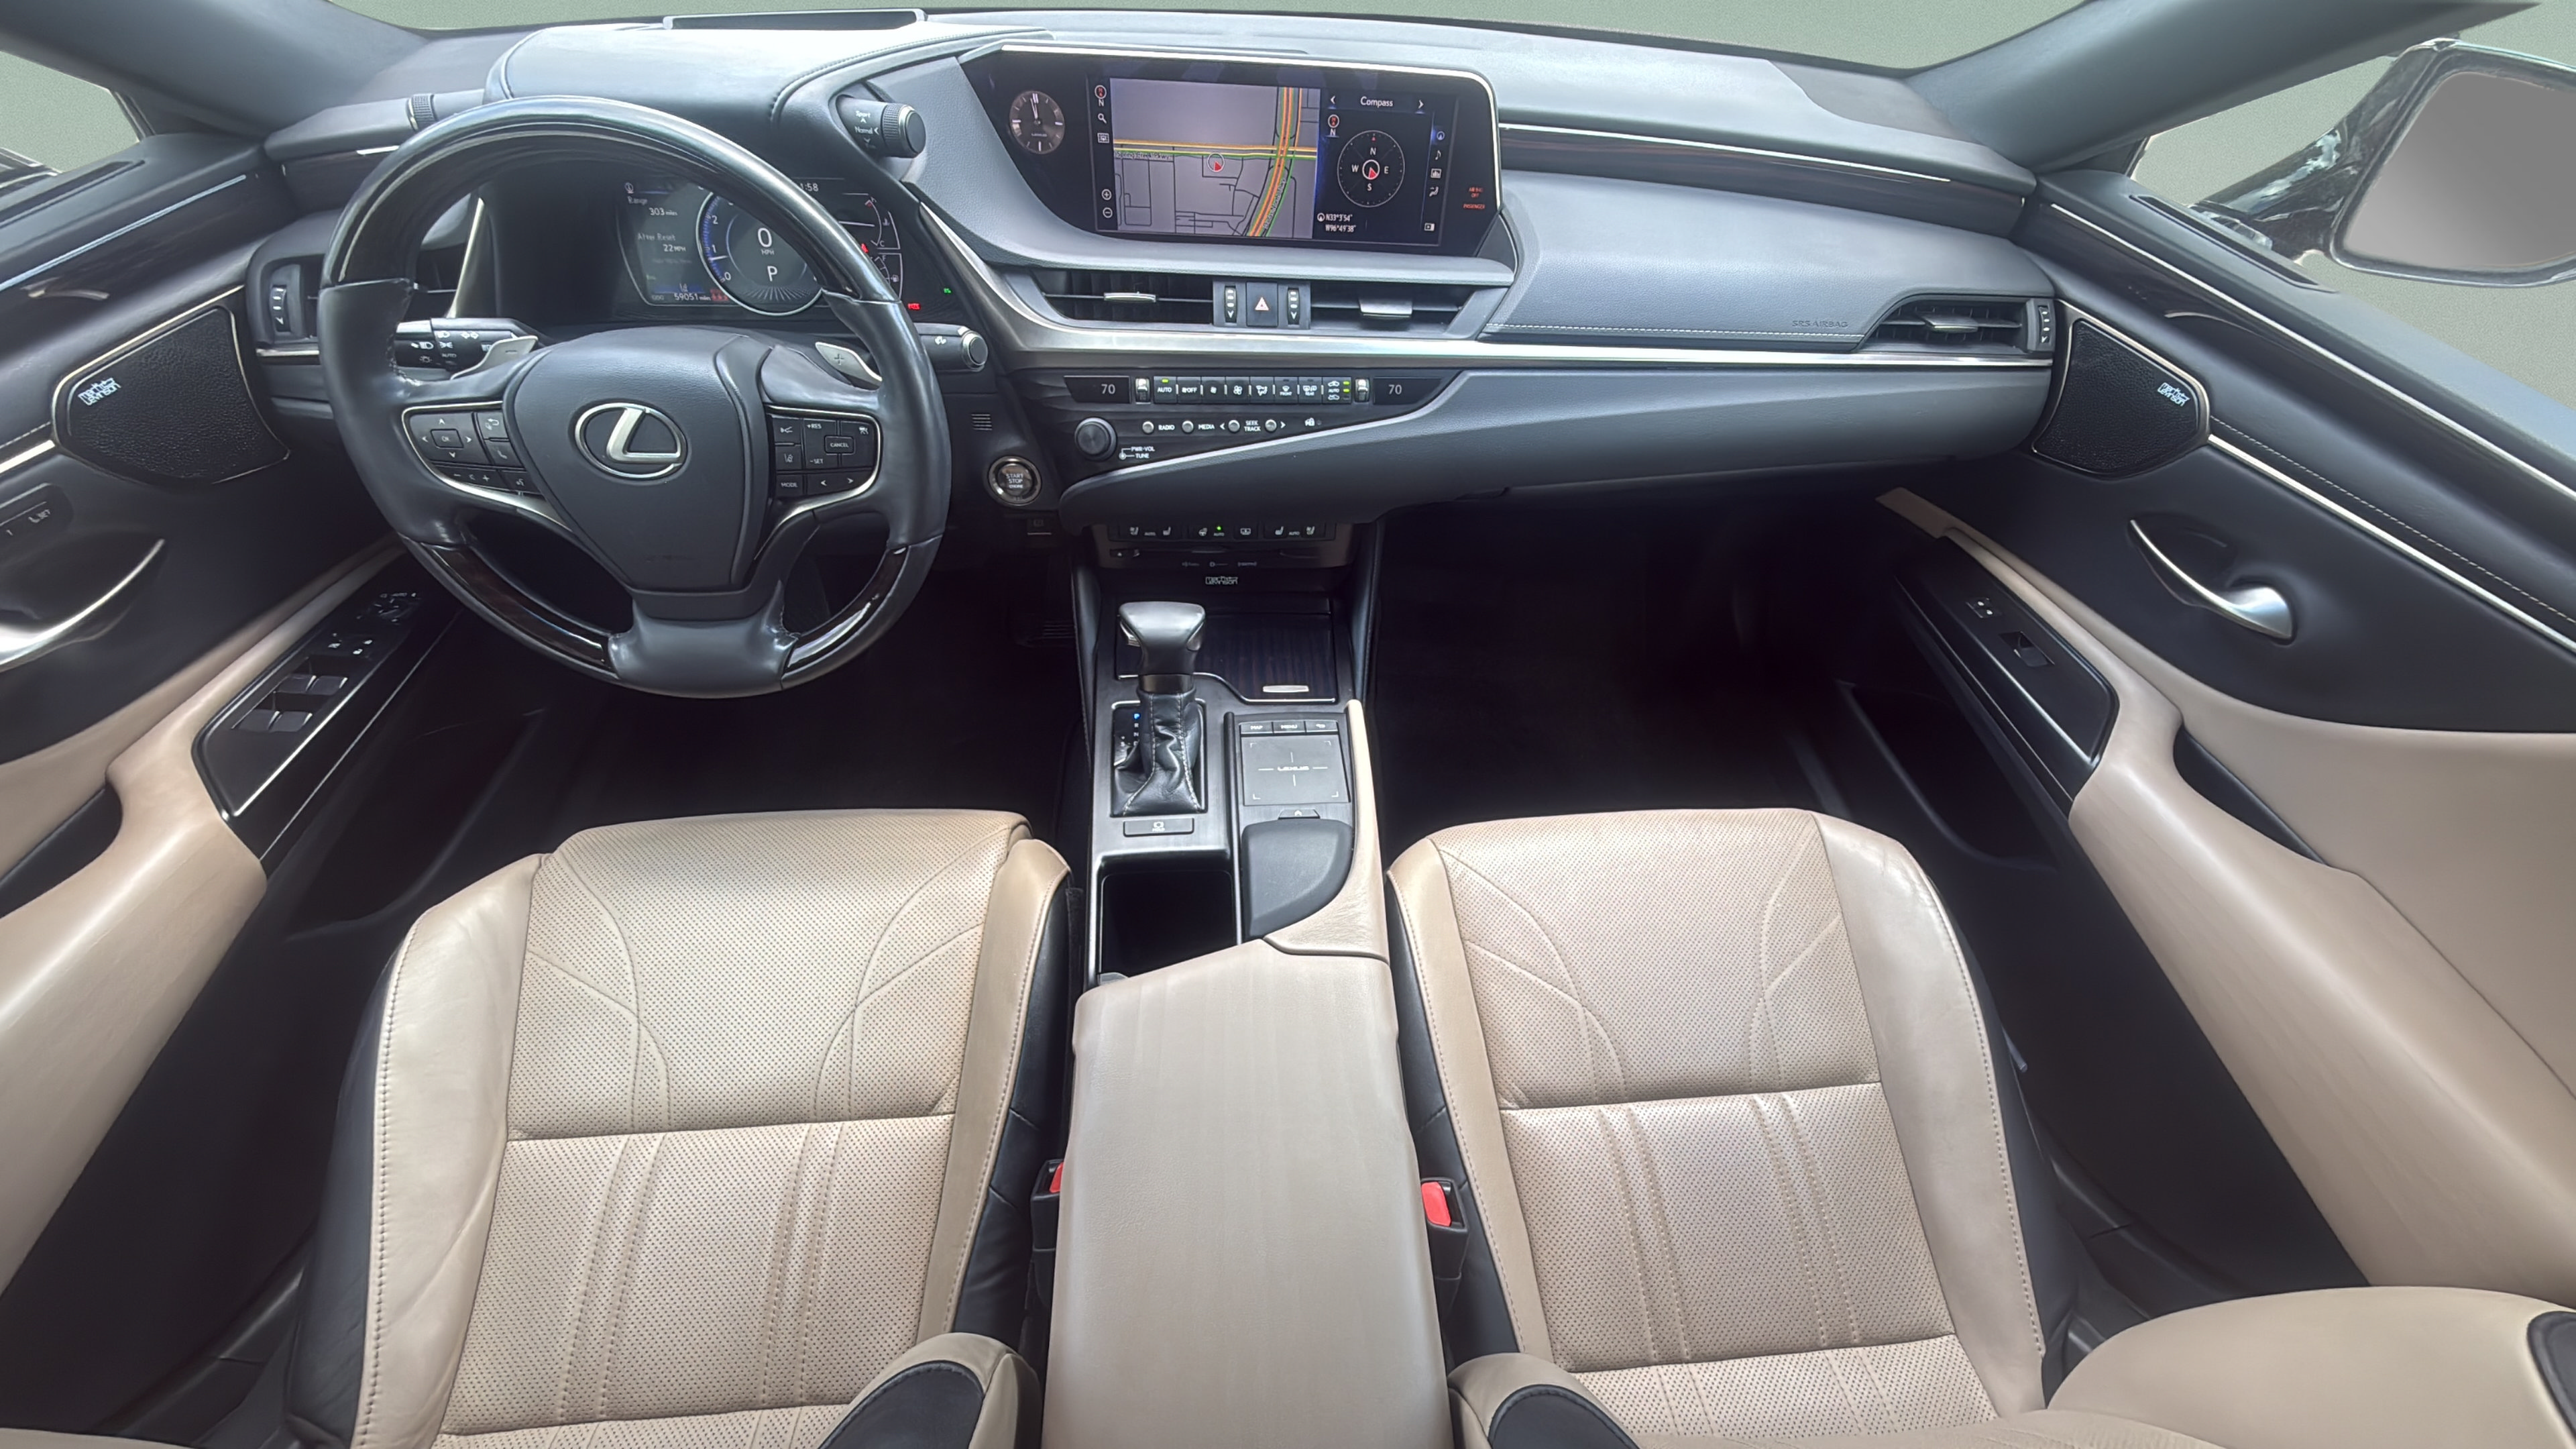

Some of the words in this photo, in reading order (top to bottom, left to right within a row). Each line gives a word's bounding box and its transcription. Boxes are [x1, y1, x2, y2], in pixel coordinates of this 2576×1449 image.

[1360, 96, 1394, 108] Compass
[855, 110, 871, 119] Sport
[854, 125, 873, 135] Normal
[1369, 147, 1376, 156] N
[1351, 164, 1359, 172] W
[1384, 166, 1389, 174] E
[1367, 182, 1372, 191] S
[649, 207, 665, 216] 303
[712, 215, 718, 225] 2
[757, 227, 773, 248] 0
[663, 244, 674, 252] 22
[712, 244, 717, 254] 1
[724, 271, 732, 281] 0
[767, 265, 779, 282] P
[673, 293, 698, 301] 59051
[1813, 321, 1849, 329] AIRBAG
[1101, 383, 1116, 394] 70
[1388, 384, 1402, 394] 70
